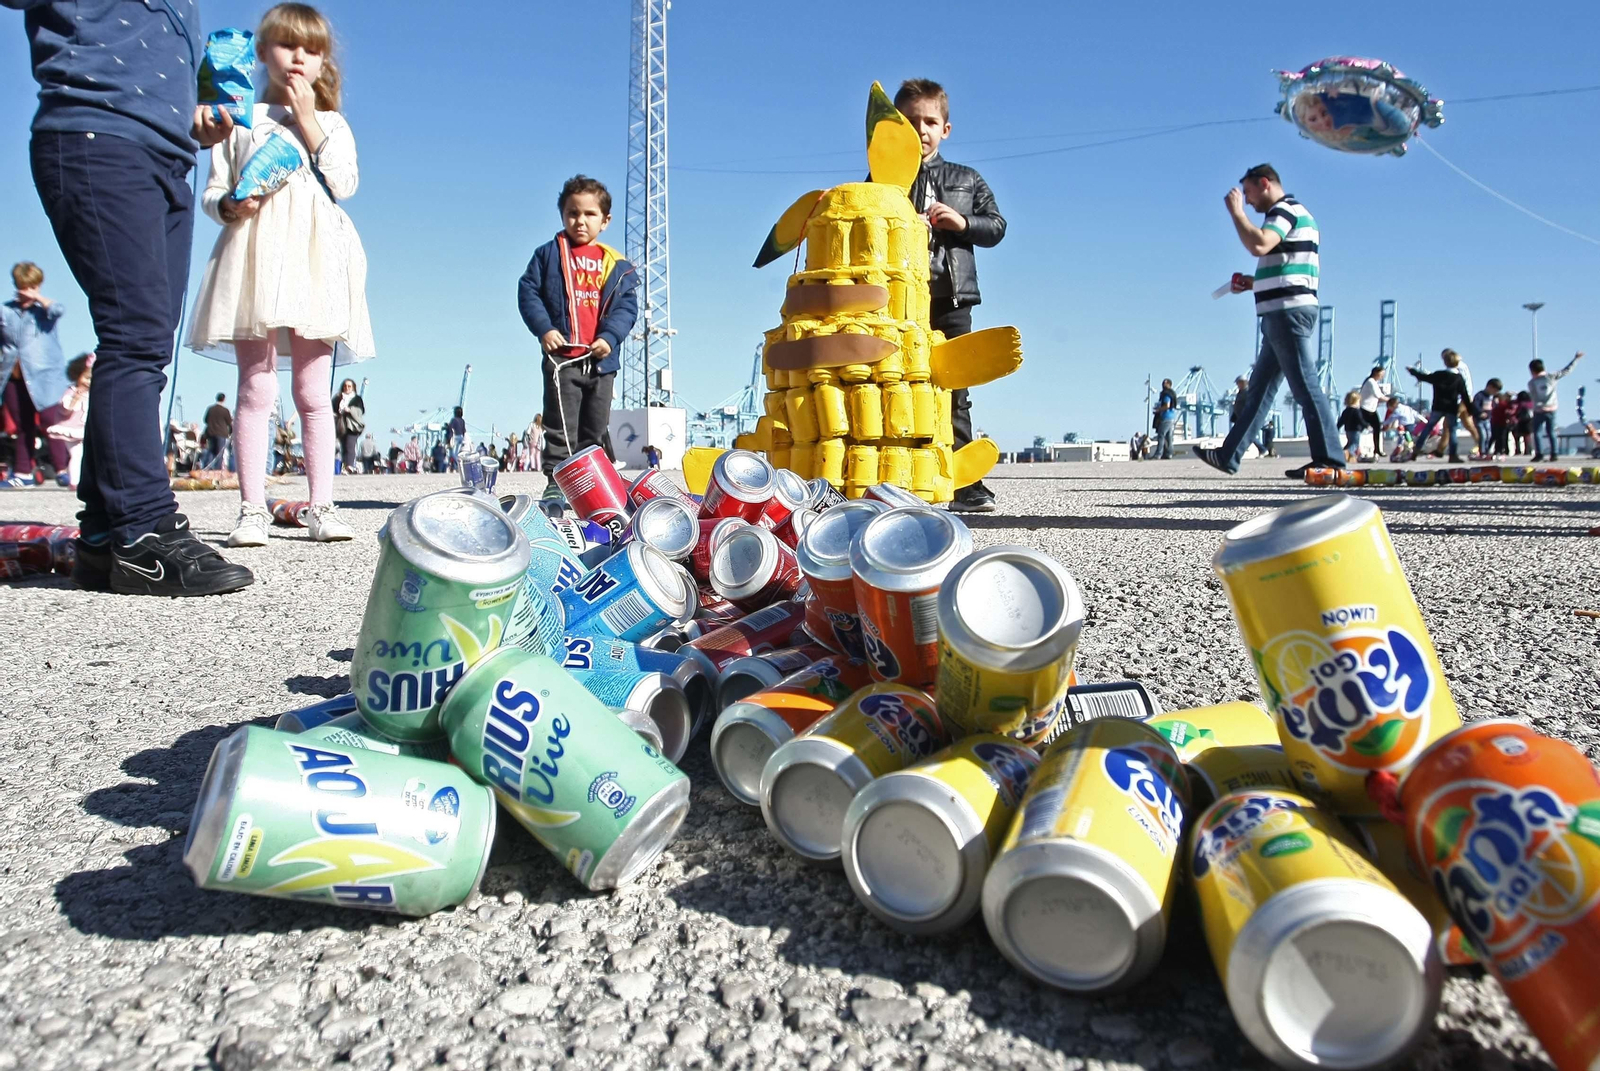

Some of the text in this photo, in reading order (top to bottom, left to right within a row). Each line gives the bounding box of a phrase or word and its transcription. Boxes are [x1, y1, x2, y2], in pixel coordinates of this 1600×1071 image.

[373, 640, 453, 667] Vive
[1321, 606, 1376, 627] LIMÓN
[1278, 630, 1430, 752] Fanta
[482, 679, 541, 802] RIUS
[526, 712, 571, 805] Vive
